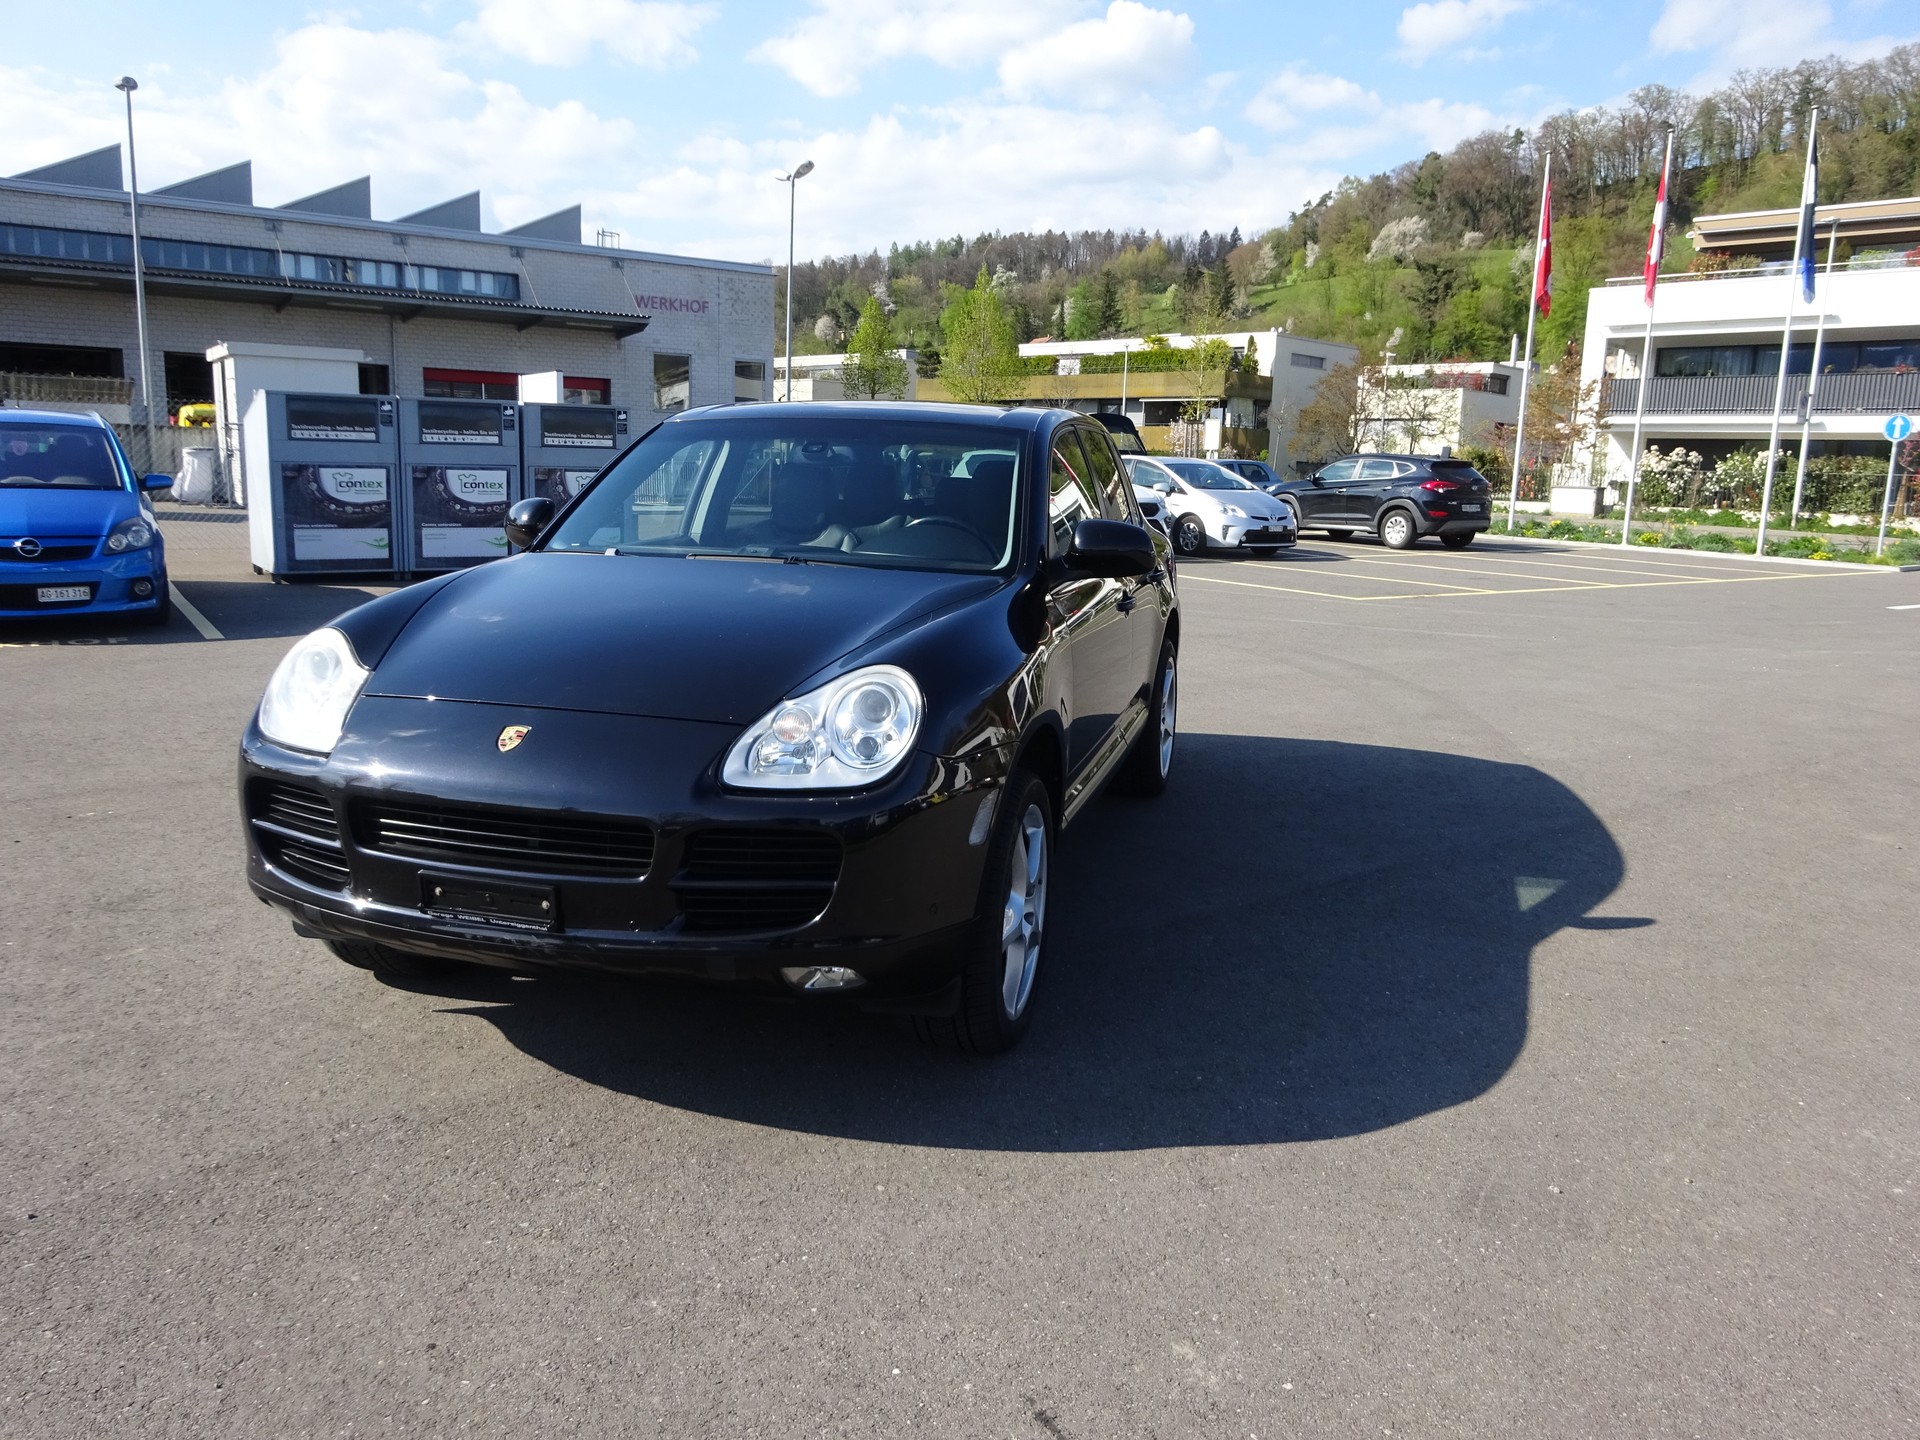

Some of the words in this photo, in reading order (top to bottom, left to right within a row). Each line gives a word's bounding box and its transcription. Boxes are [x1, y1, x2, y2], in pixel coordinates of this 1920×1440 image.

[635, 294, 709, 314] WERKHOF
[338, 480, 383, 488] contex
[463, 480, 504, 489] contex
[40, 590, 53, 599] AG
